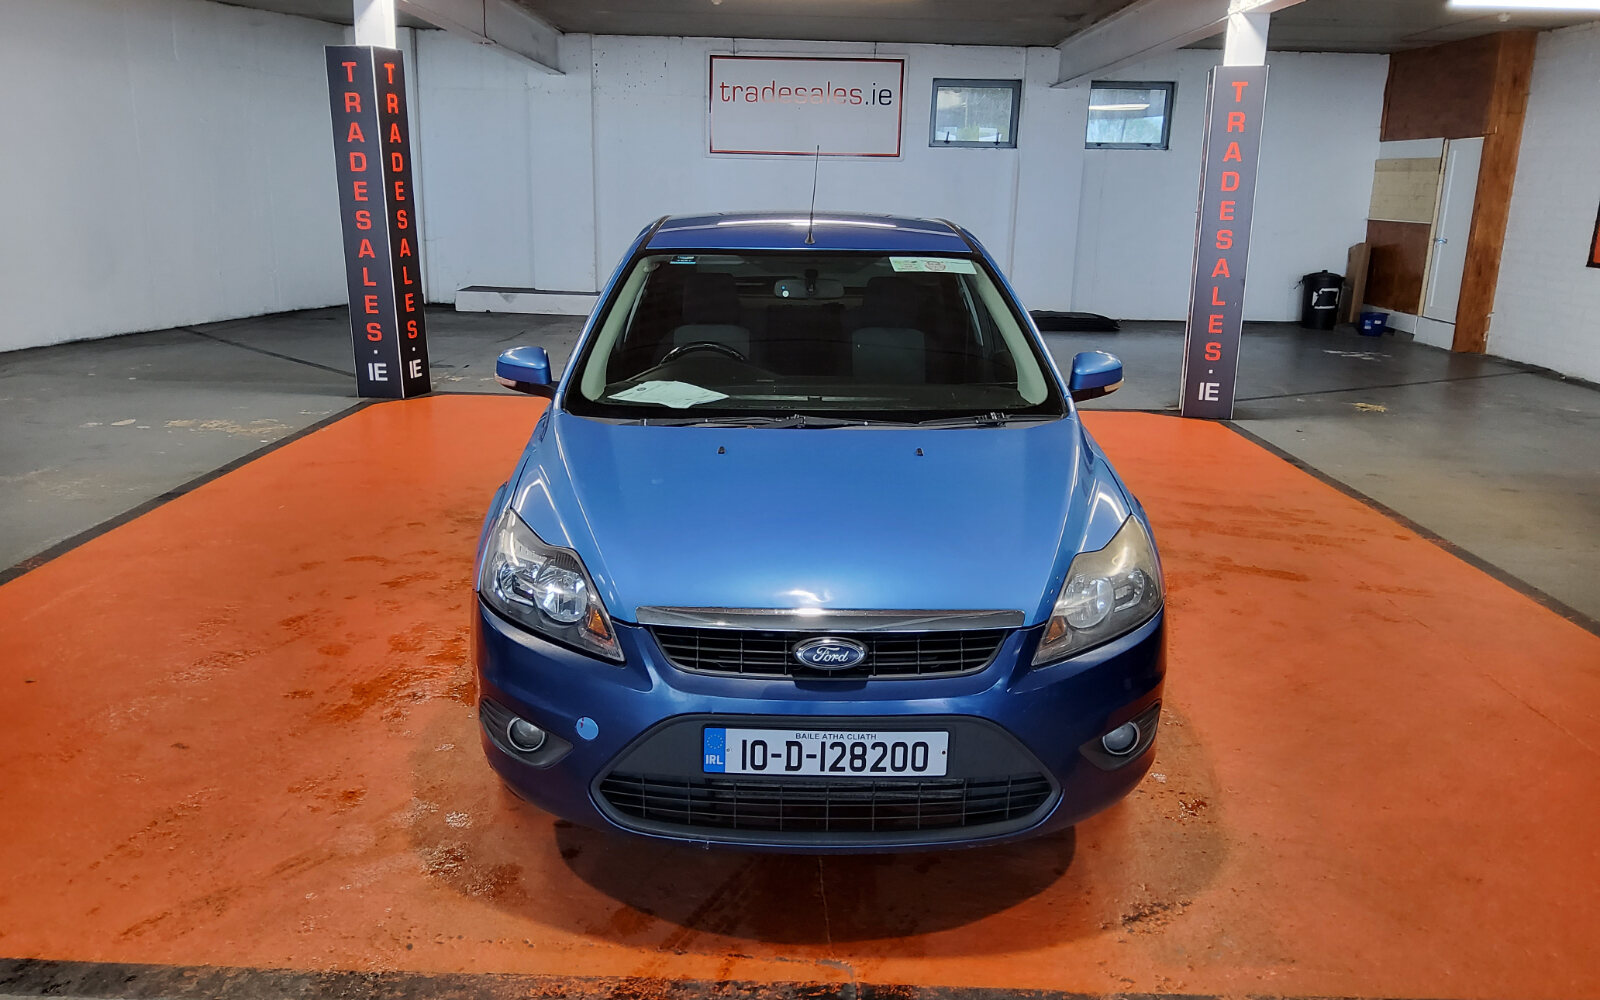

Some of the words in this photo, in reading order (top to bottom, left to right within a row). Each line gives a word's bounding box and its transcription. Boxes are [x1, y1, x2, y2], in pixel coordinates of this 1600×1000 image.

[719, 80, 892, 106] tradesales.ie
[812, 646, 850, 662] Ford
[795, 732, 820, 740] BAILE
[705, 754, 724, 765] IRL
[741, 739, 929, 772] 10-D-128200
